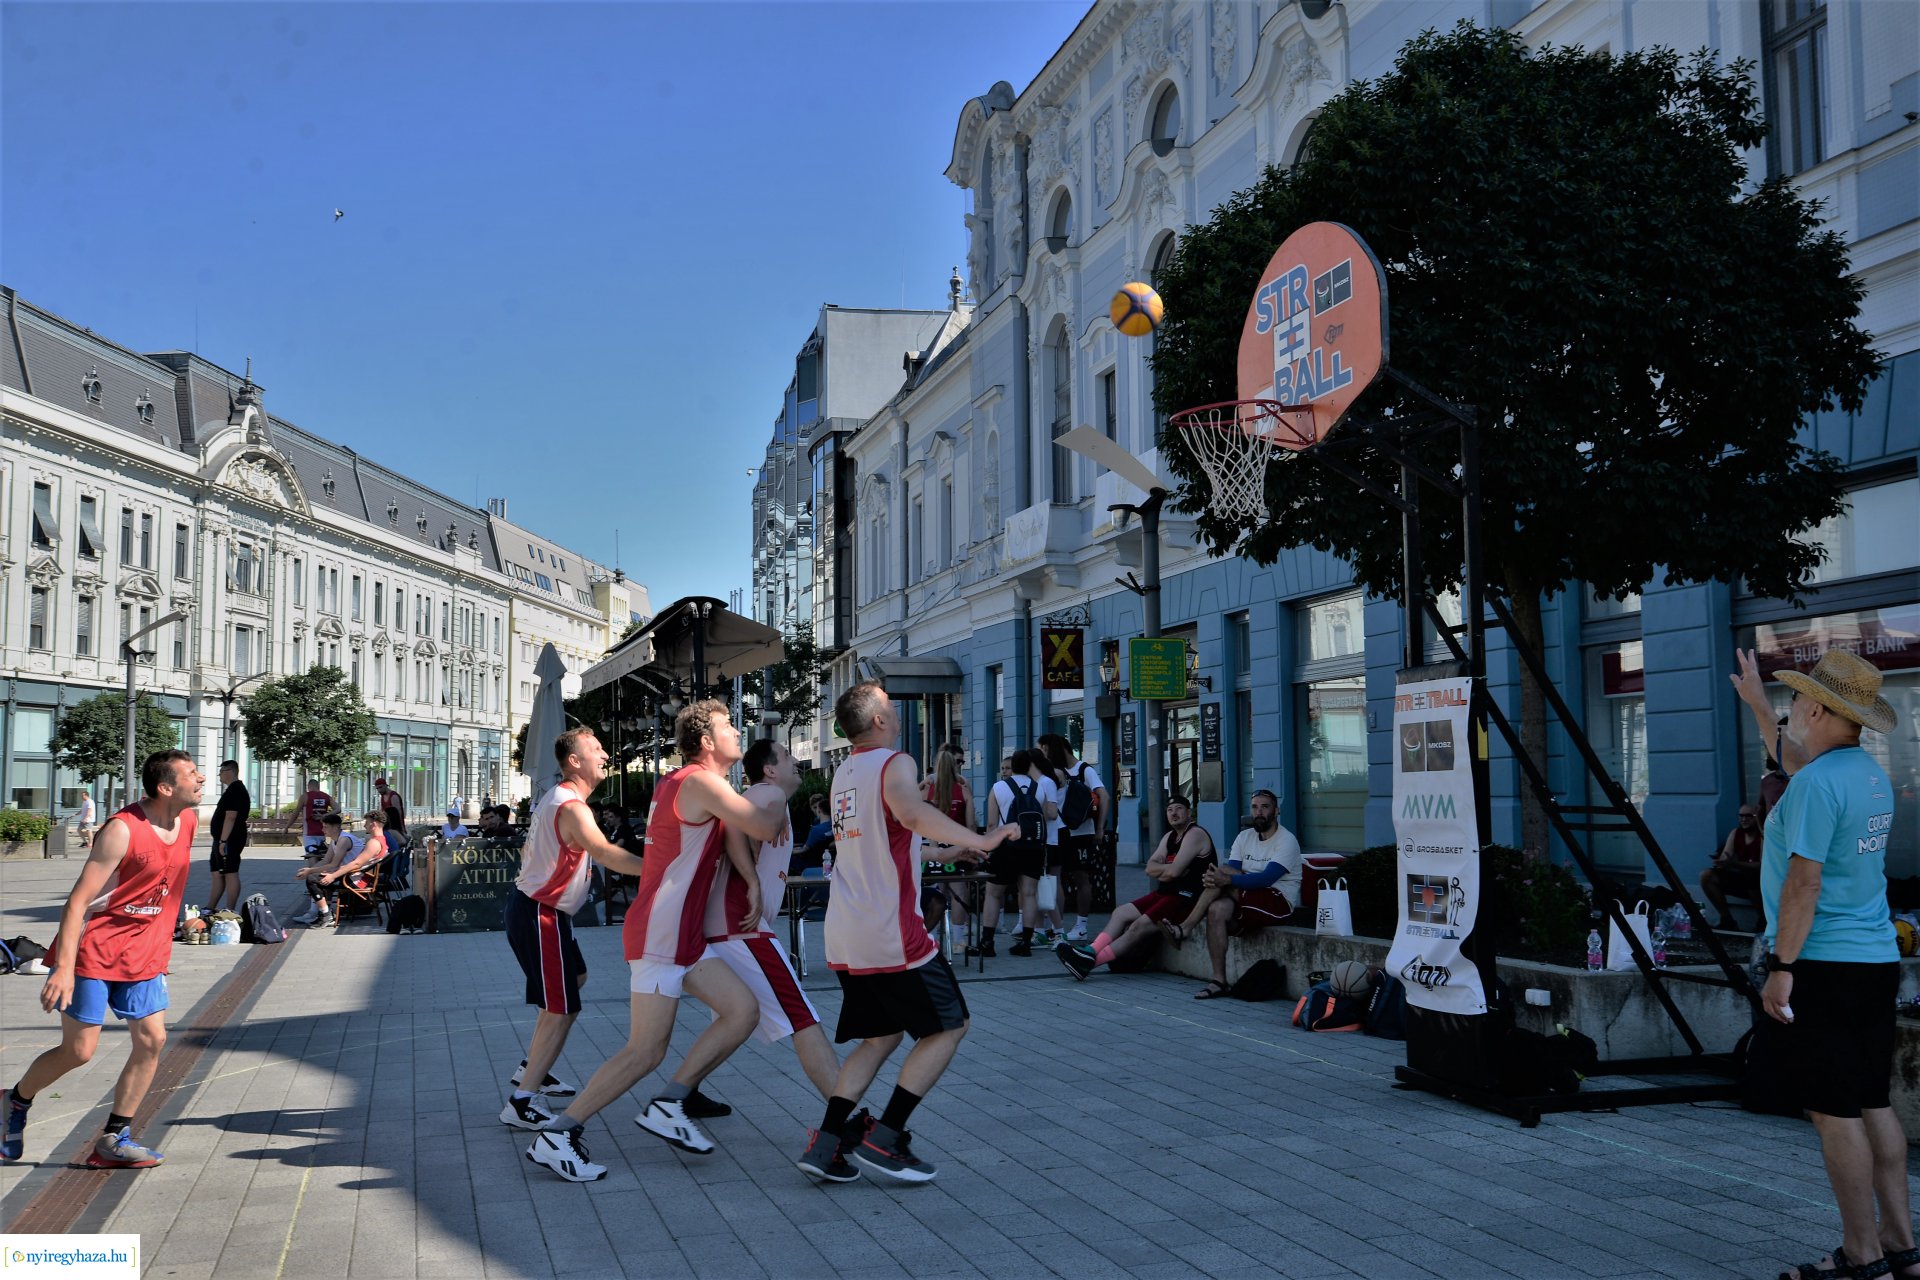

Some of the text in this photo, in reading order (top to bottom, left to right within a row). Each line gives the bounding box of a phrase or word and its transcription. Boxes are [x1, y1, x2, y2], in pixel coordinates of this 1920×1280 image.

[1048, 634, 1078, 668] X
[1794, 637, 1908, 664] BUDEST BANK
[1428, 741, 1452, 749] MKOSZ
[1402, 794, 1456, 819] MVM
[1077, 848, 1088, 861] 14
[1416, 845, 1464, 855] GROSBASKET
